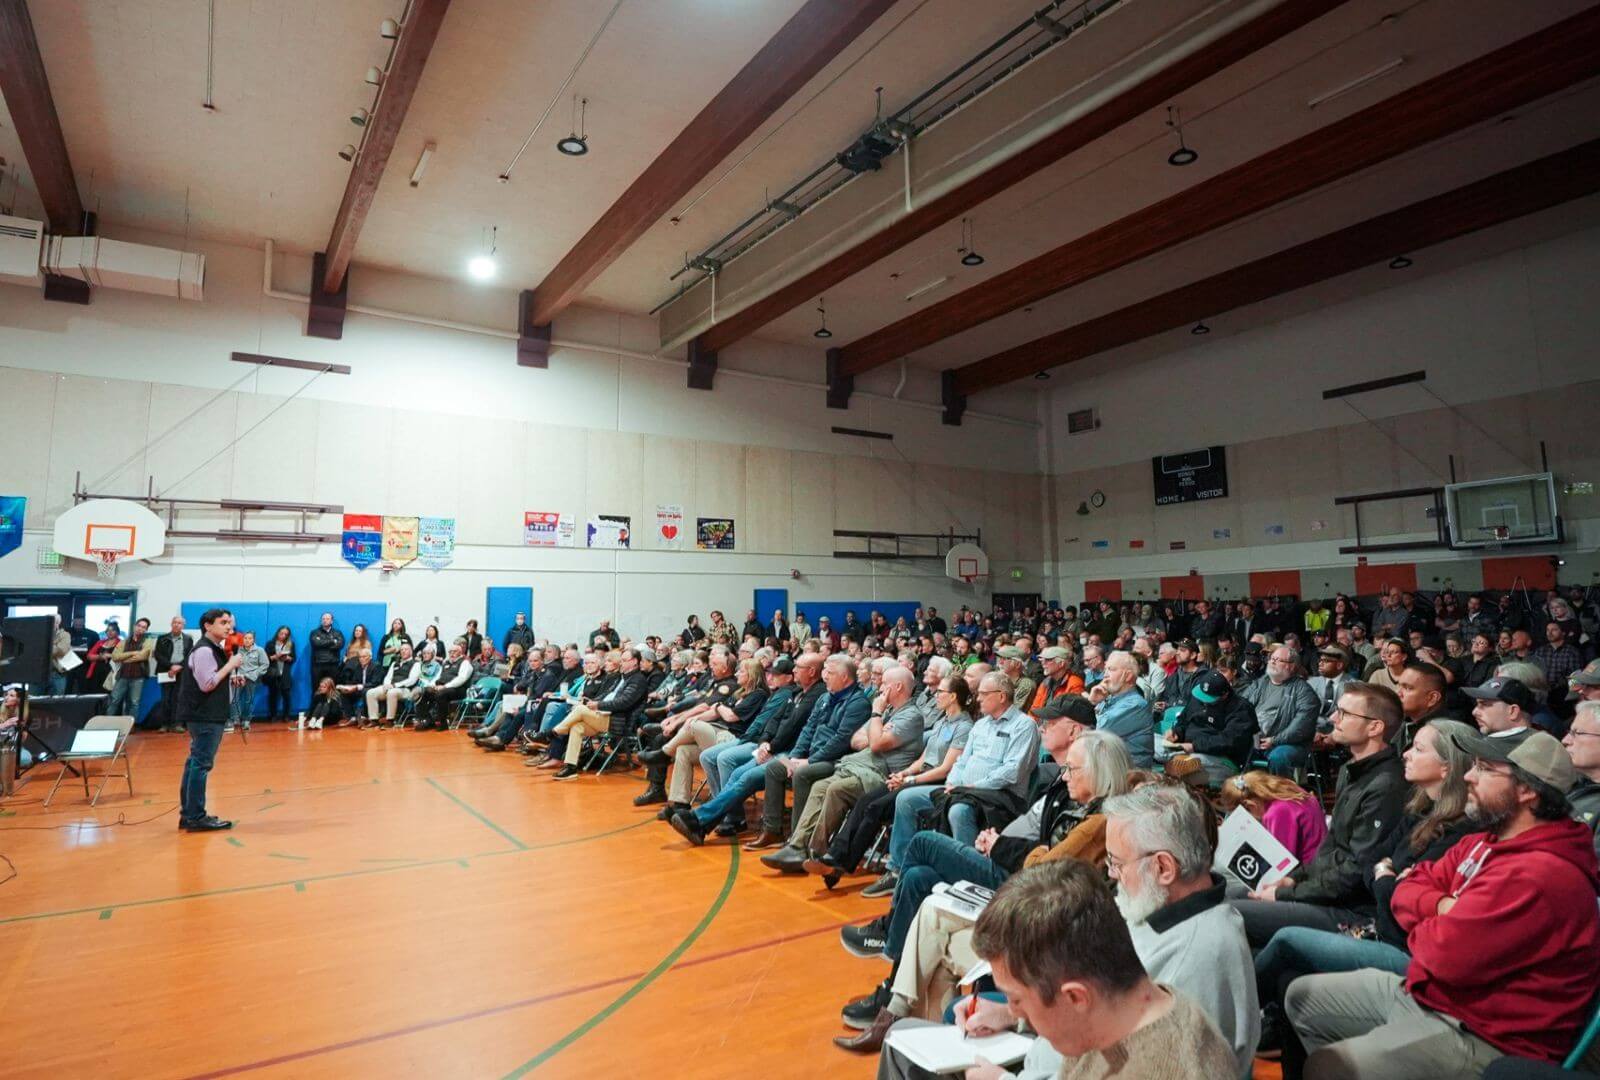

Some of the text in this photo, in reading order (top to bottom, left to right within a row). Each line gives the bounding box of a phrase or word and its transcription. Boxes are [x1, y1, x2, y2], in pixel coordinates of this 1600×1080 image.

[1157, 488, 1223, 504] HOME VISITOR
[864, 938, 886, 947] HOKA
